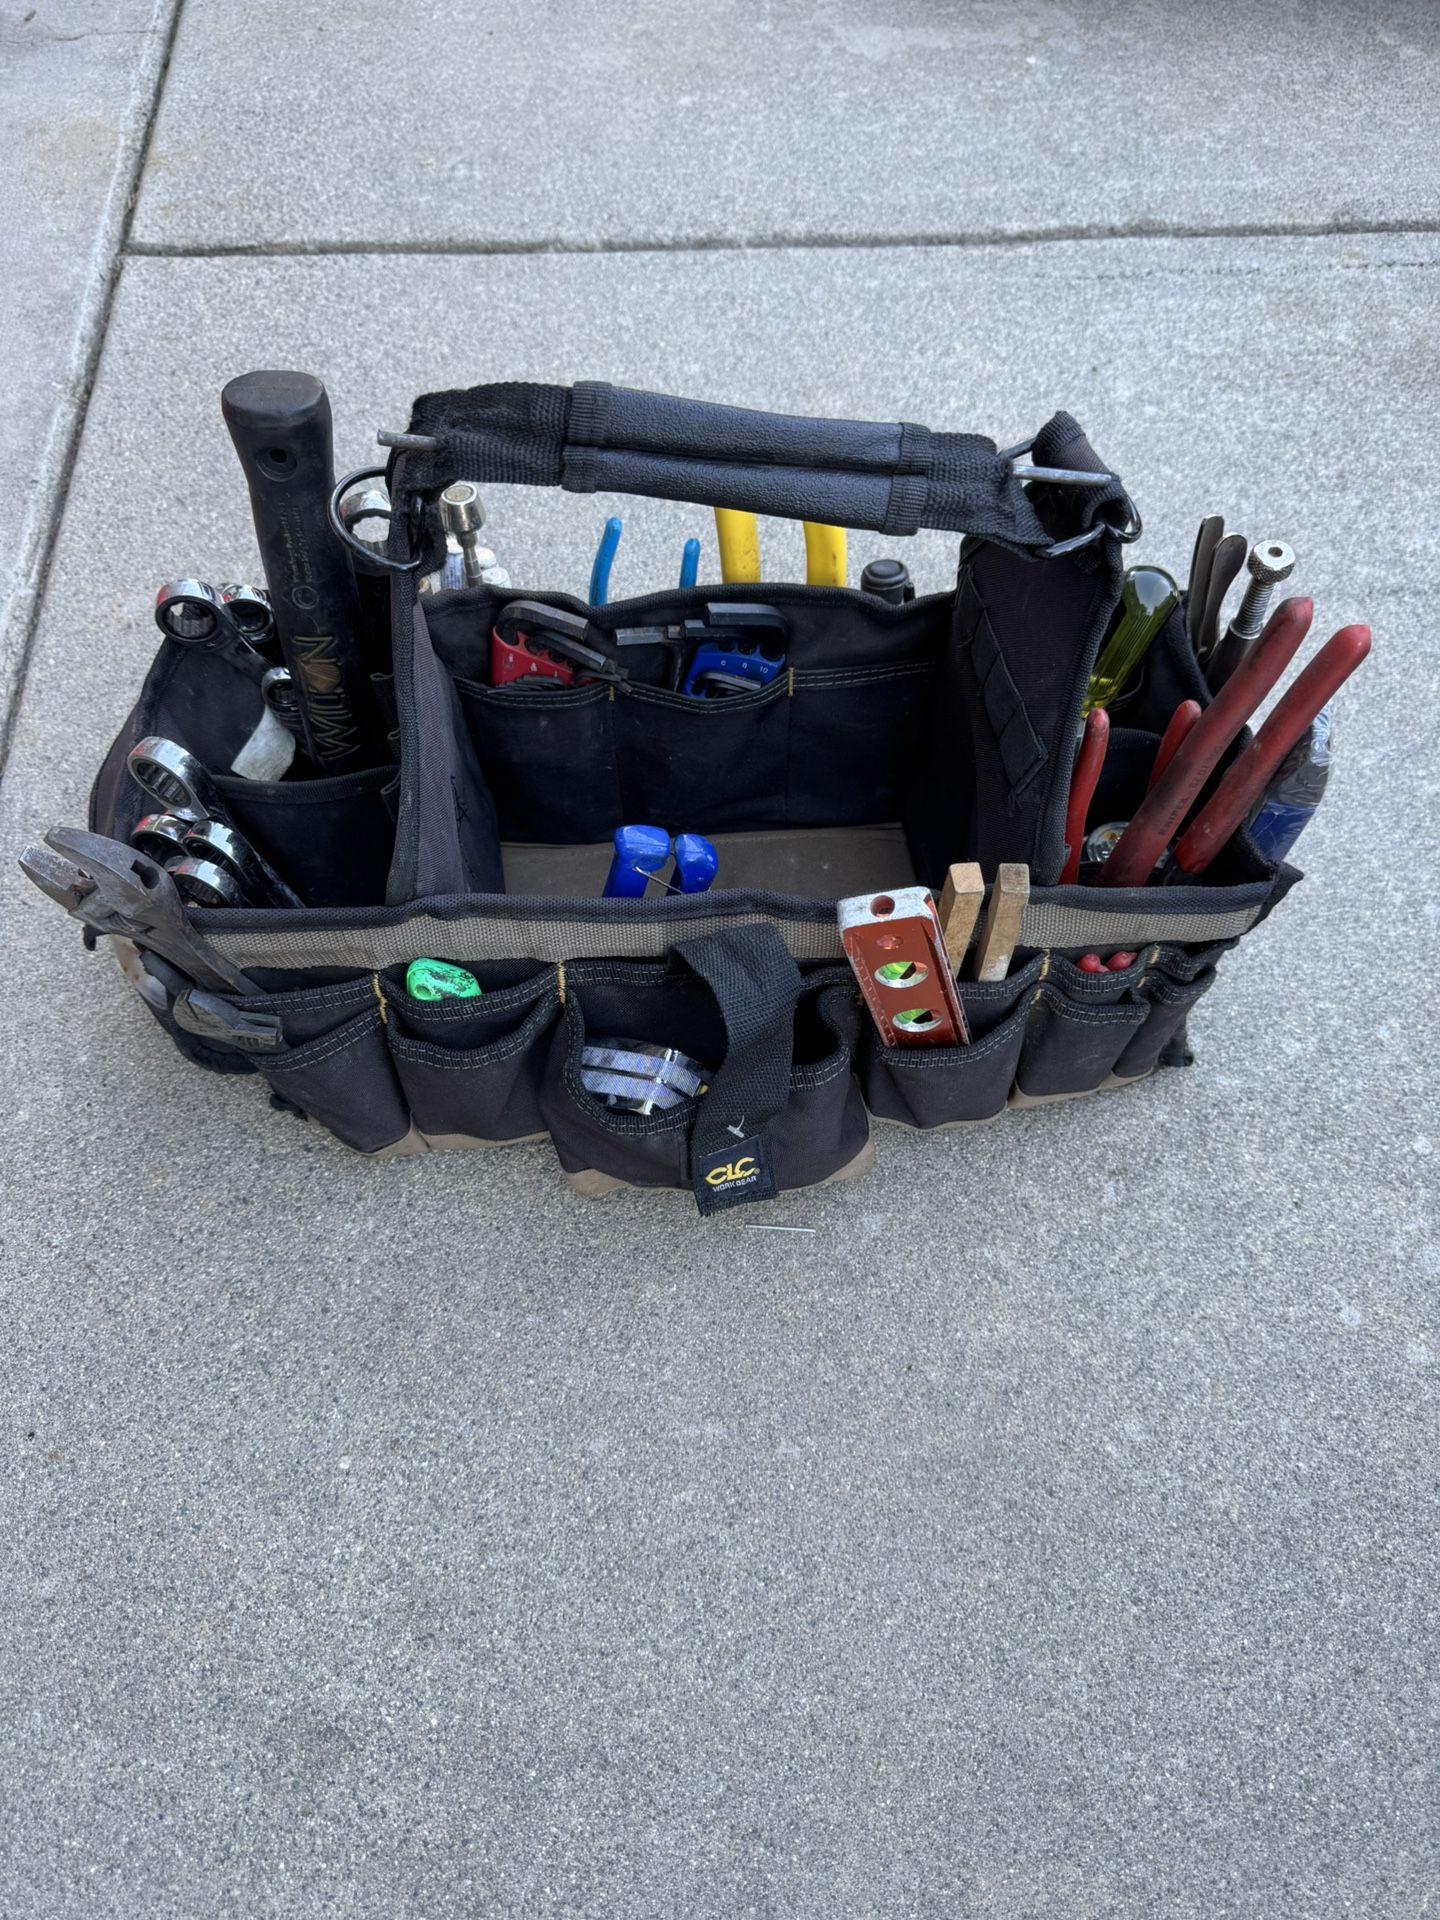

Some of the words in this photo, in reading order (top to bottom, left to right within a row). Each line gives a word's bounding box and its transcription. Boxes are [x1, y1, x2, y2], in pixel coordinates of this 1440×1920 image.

[759, 666, 768, 674] 10
[292, 634, 360, 761] WILTON
[705, 1157, 755, 1185] CLC
[712, 1181, 735, 1192] WORK
[736, 1175, 757, 1186] GEAR
